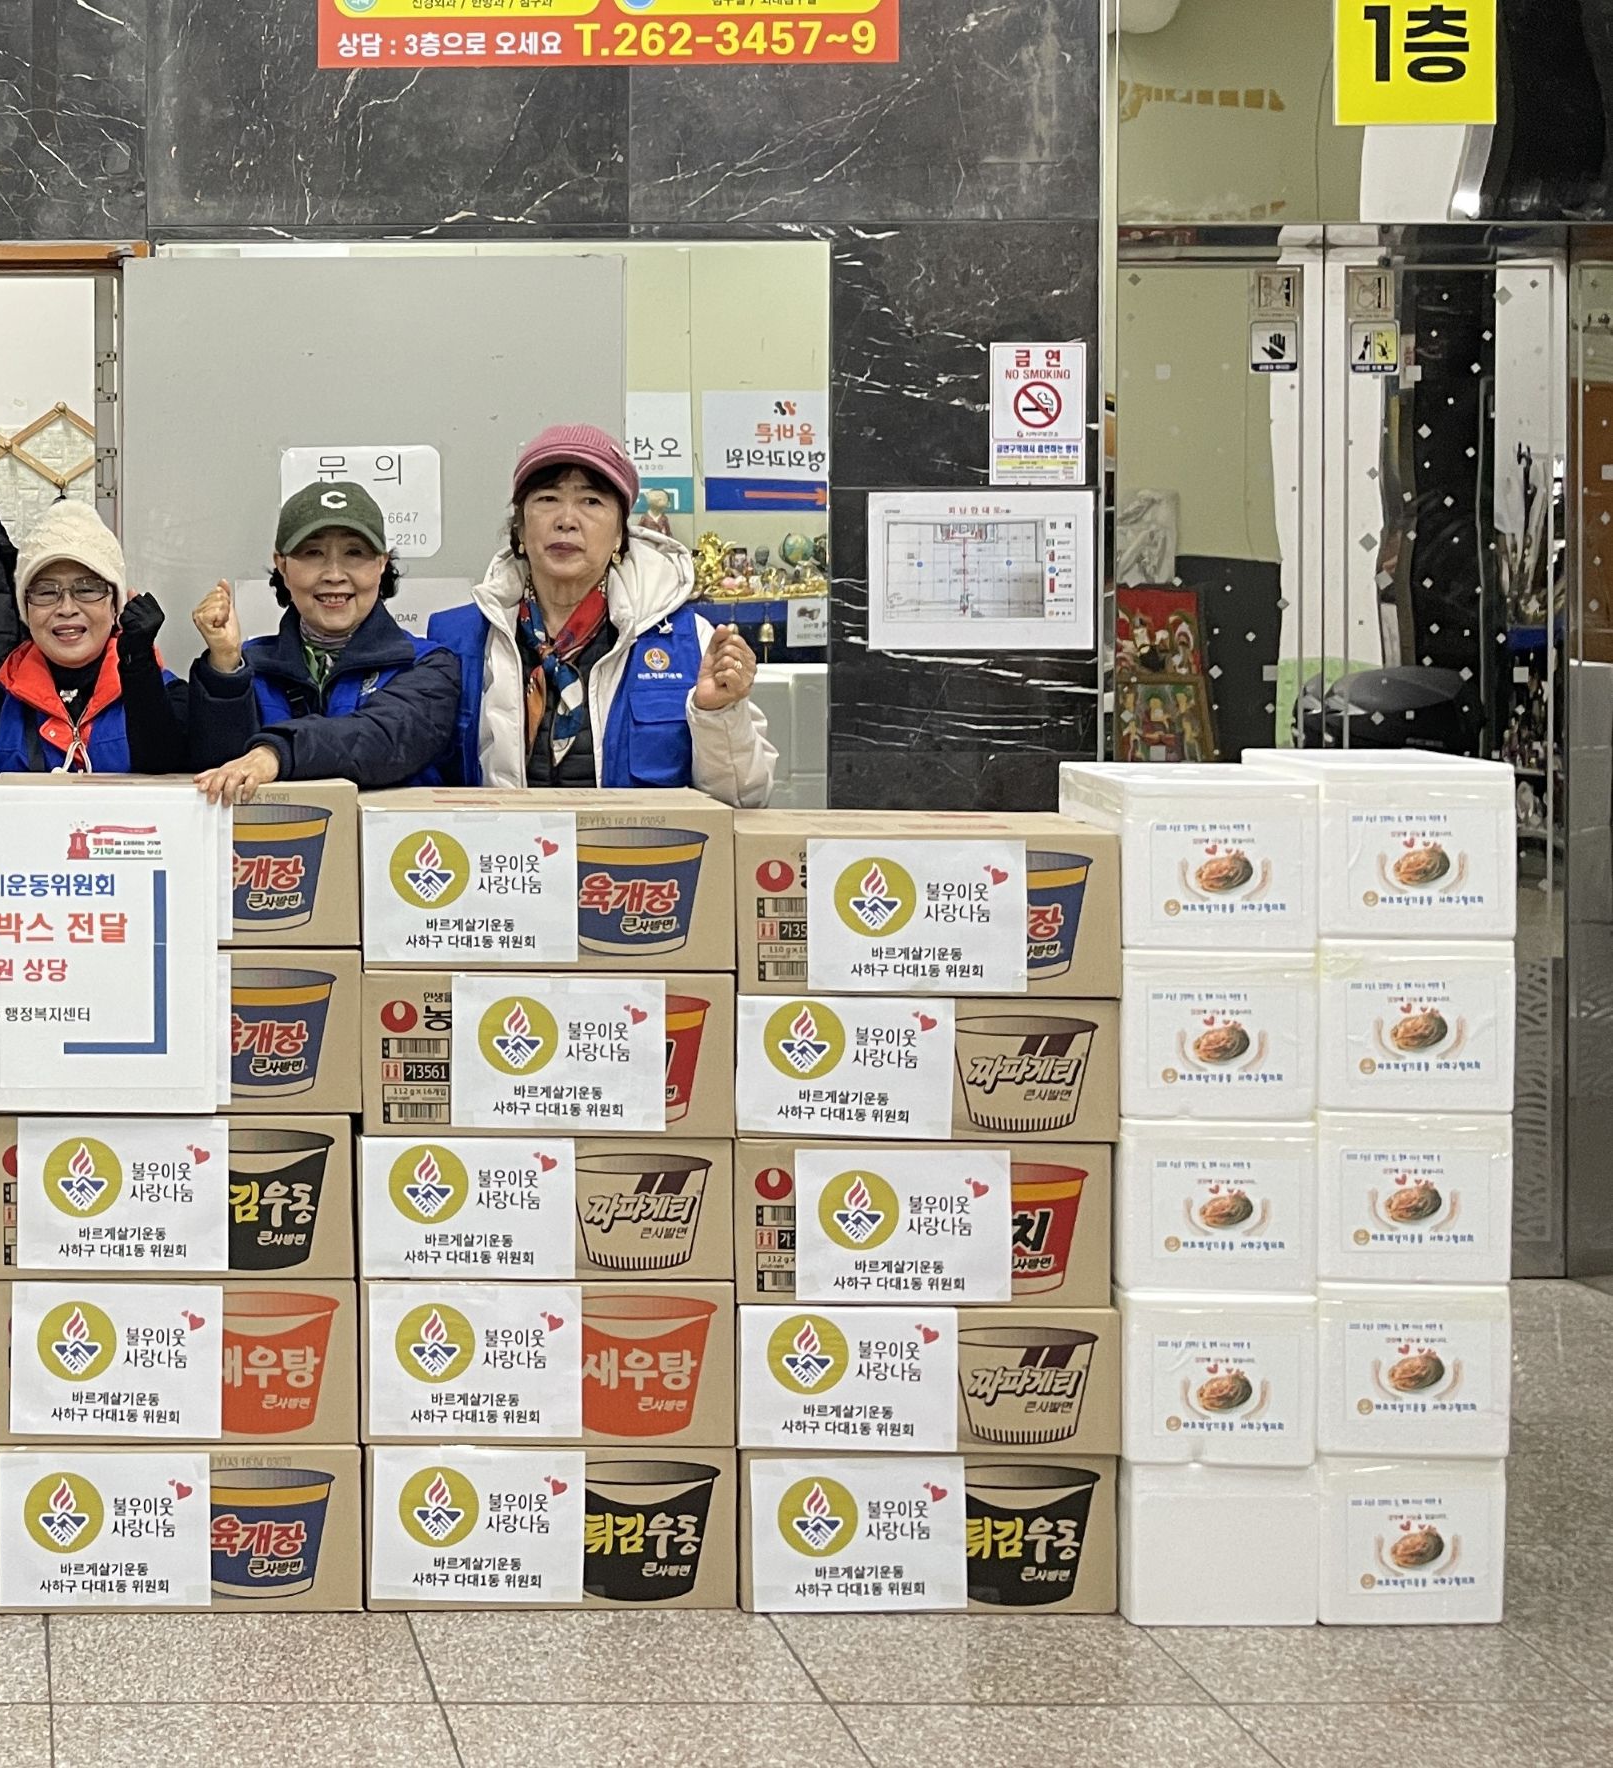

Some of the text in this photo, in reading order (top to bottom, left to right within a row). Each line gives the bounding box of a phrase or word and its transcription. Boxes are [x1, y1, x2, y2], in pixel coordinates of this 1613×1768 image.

[338, 33, 382, 57] 상담
[405, 32, 486, 56] 3층으로
[495, 32, 561, 55] 오세요
[574, 21, 876, 56] T.262-3457~9
[1364, 5, 1469, 82] 1층
[1015, 350, 1060, 367] 금연
[1005, 367, 1070, 379] NO SMOKING
[321, 491, 347, 508] C
[480, 854, 539, 873] 불우이웃
[477, 876, 541, 894] 사랑나눔
[580, 872, 680, 915] 육개장
[67, 913, 127, 943] 전달
[426, 918, 514, 932] 바르게살기운동
[620, 916, 675, 934] 큰사발면
[406, 935, 535, 948] 사하구 다대1동 위원회
[23, 959, 68, 982] 상당
[5, 1007, 90, 1022] 행정복지센터
[585, 1193, 697, 1233] 짜파게티
[967, 1366, 1085, 1405] 짜파게티
